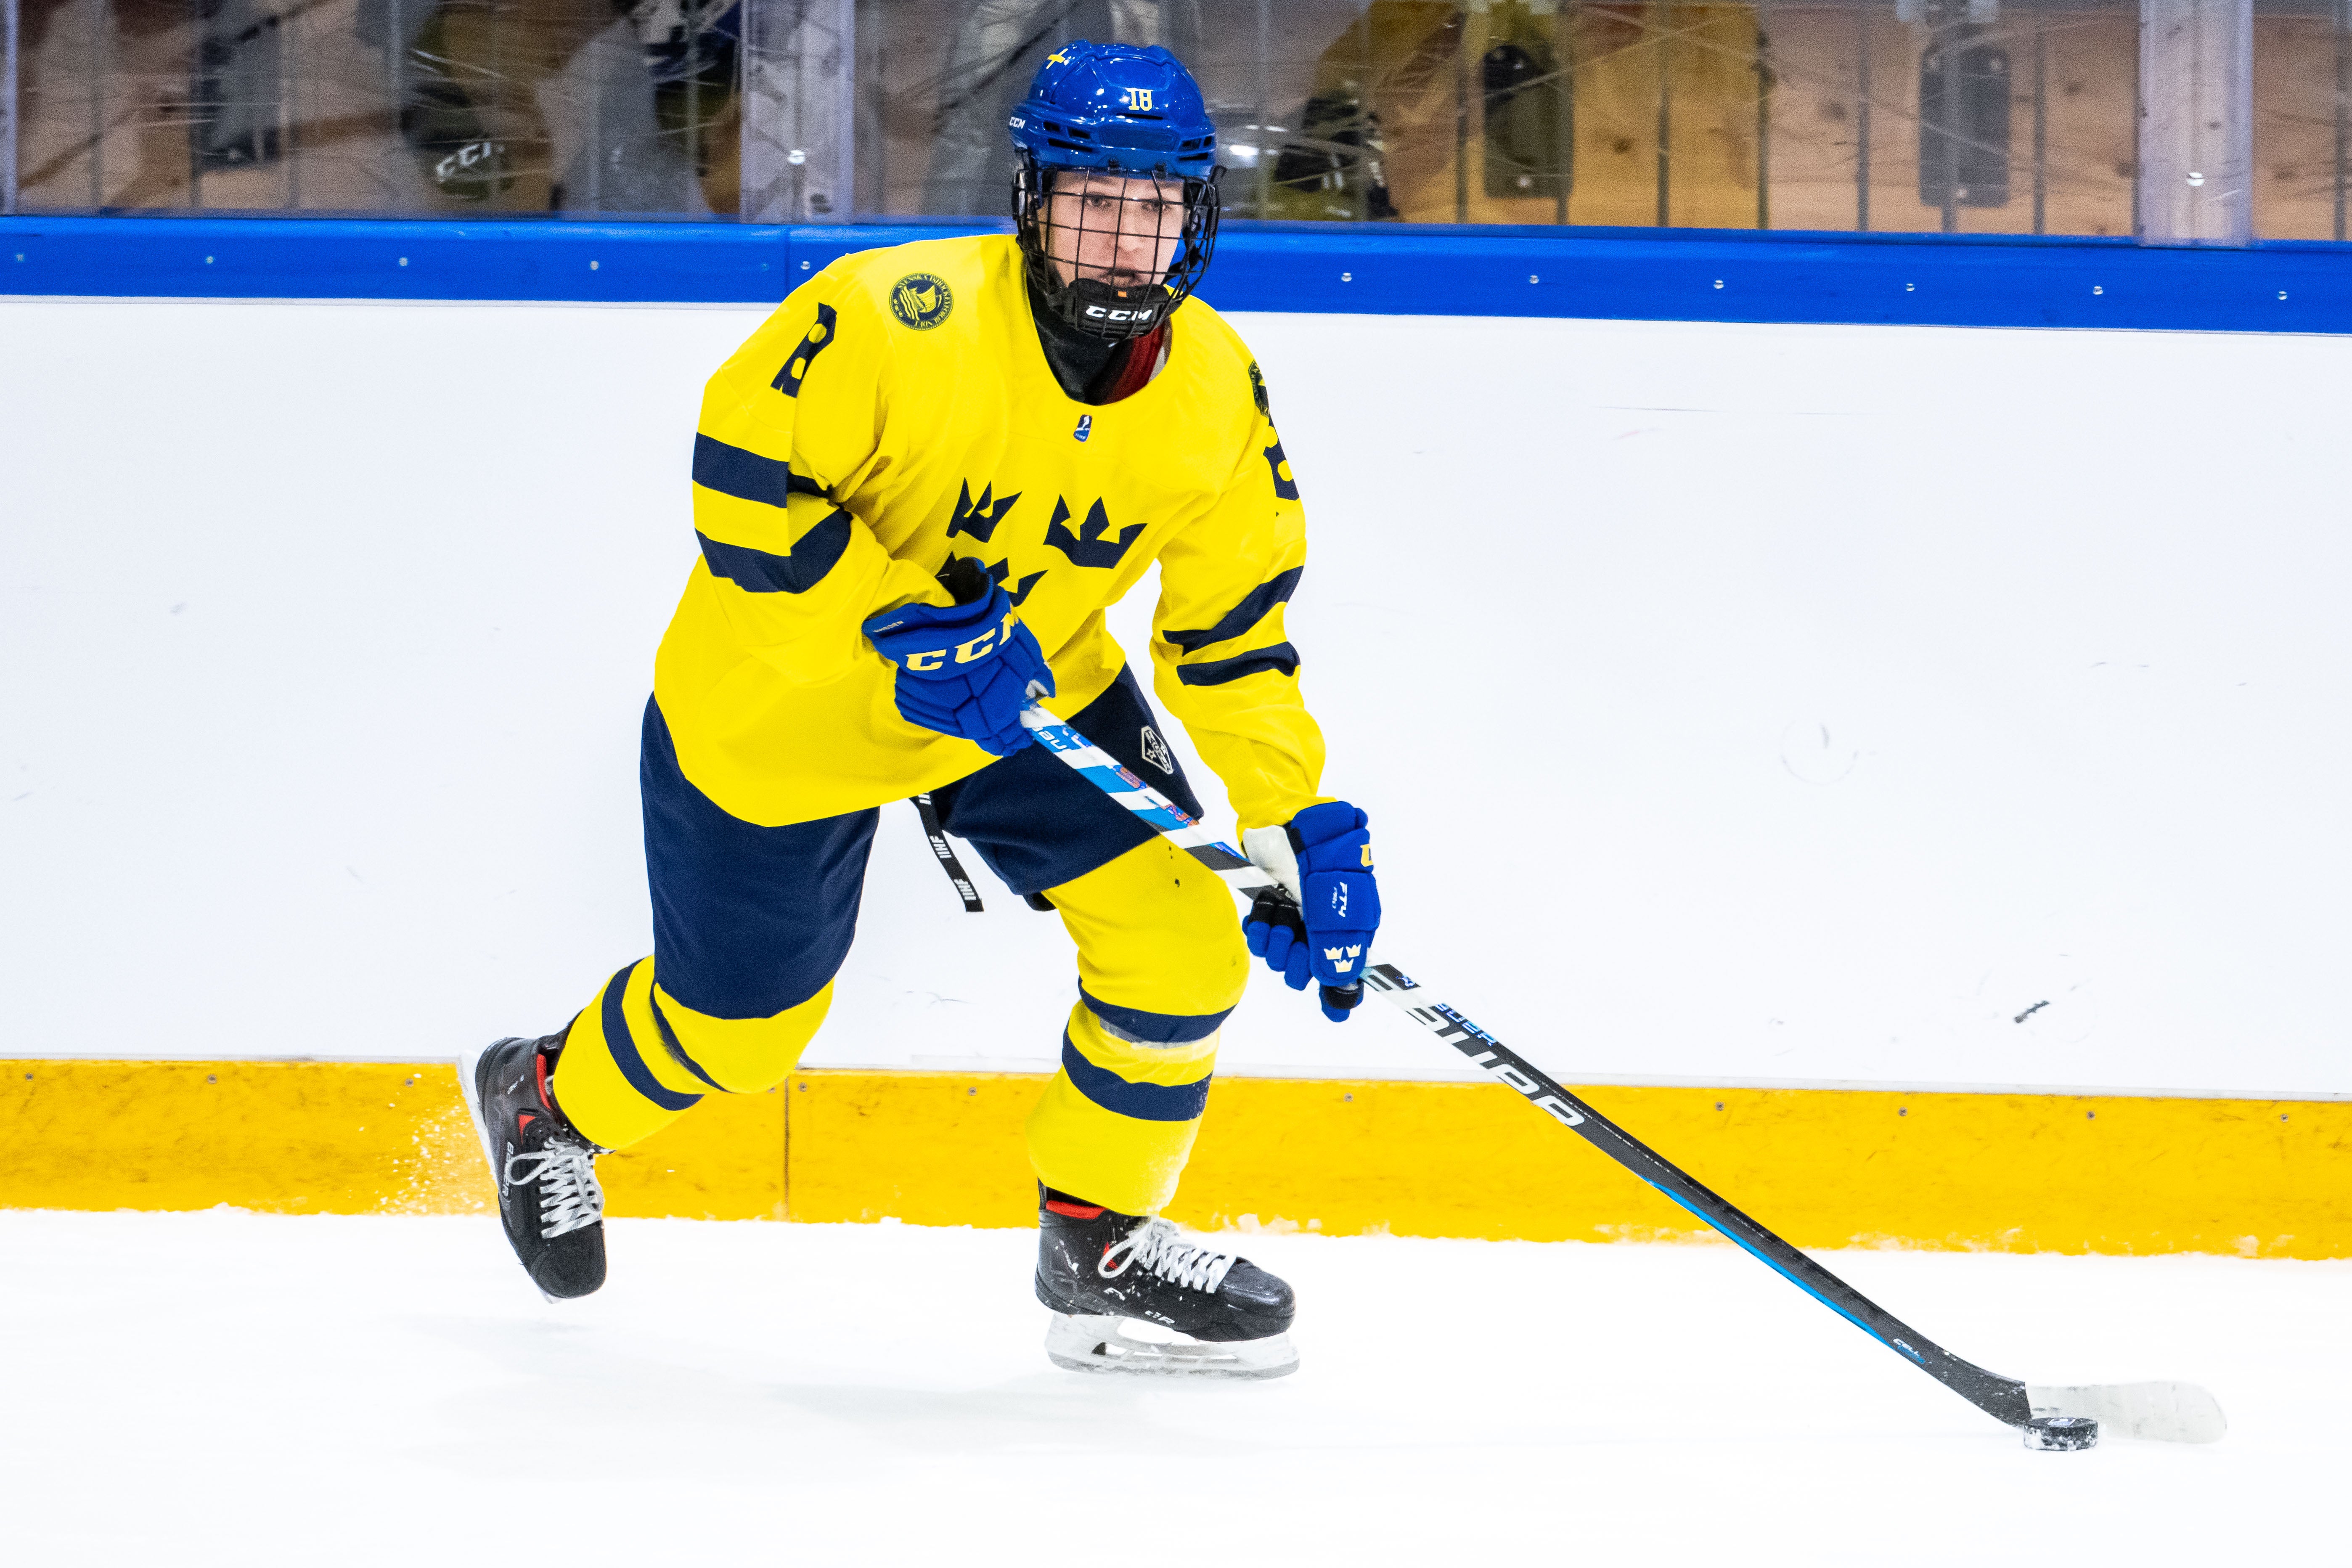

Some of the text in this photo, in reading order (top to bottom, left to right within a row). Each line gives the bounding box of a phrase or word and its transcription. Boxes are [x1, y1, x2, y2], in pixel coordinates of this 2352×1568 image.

[1127, 87, 1153, 111] 18
[1009, 116, 1025, 129] CCM
[1085, 305, 1153, 321] CCM
